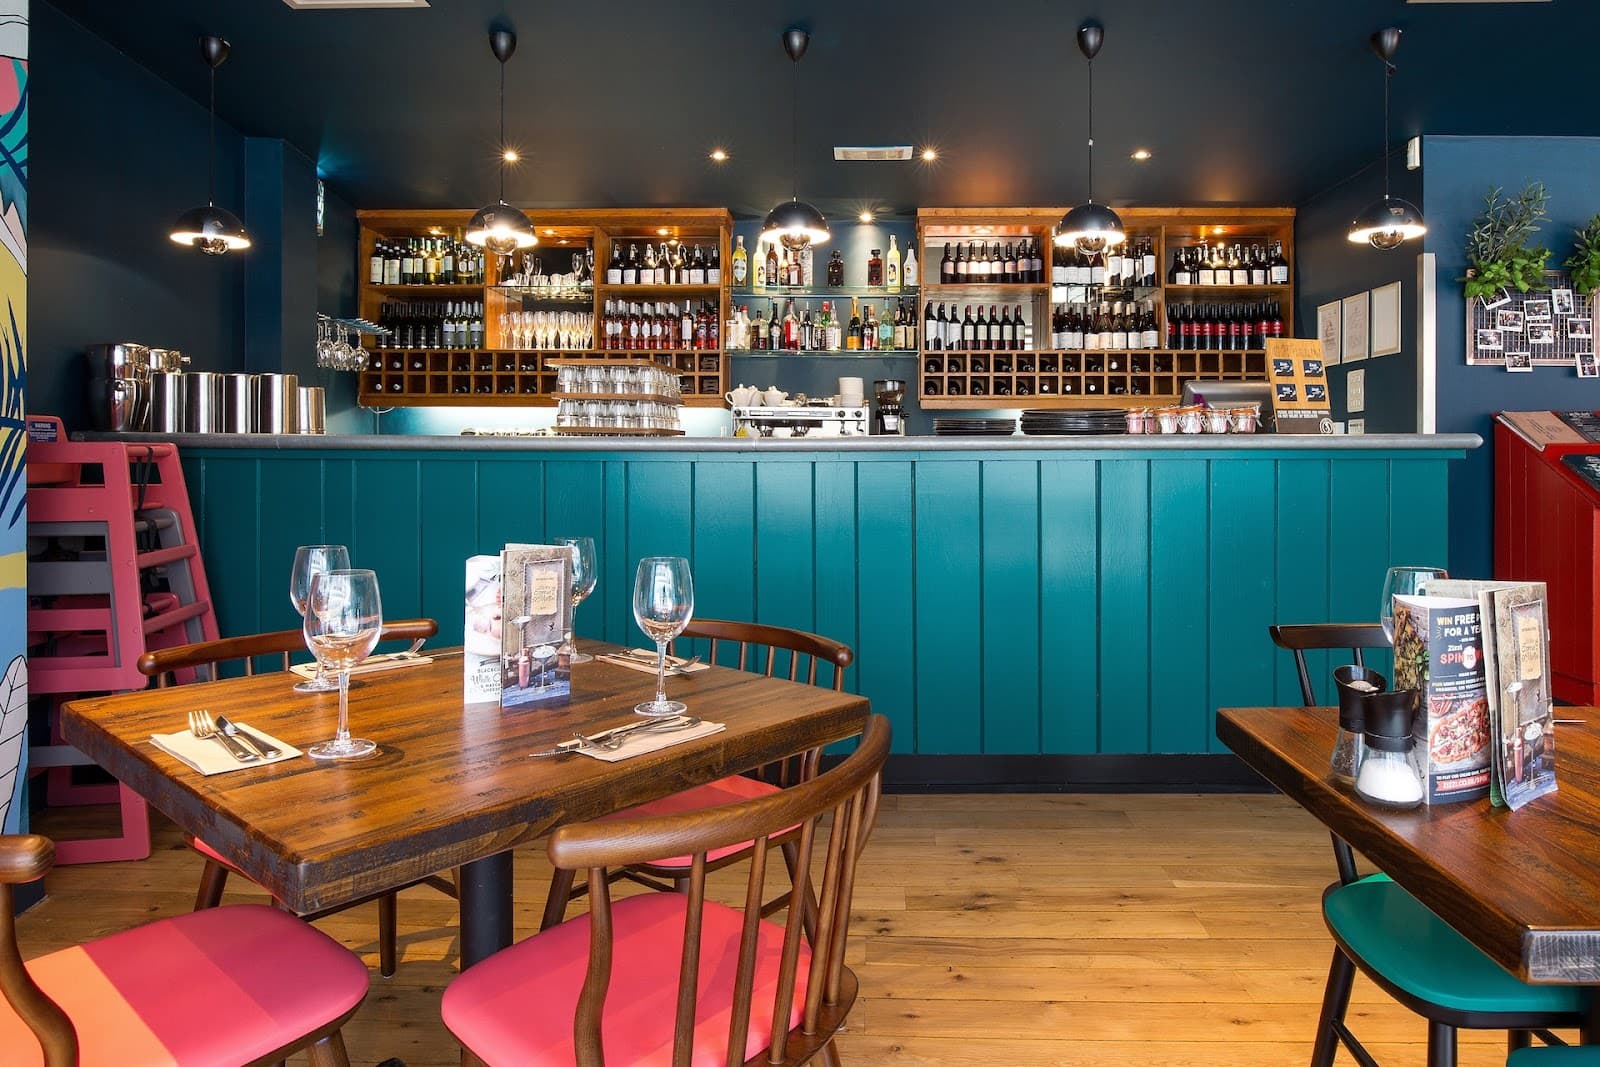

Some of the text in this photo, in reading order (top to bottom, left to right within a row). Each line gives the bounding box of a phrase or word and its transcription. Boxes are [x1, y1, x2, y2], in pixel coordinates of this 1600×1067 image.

[1436, 616, 1453, 626] WIN
[1454, 614, 1475, 625] FREE
[1444, 625, 1481, 637] FOR A YE
[1440, 653, 1464, 664] SPIN
